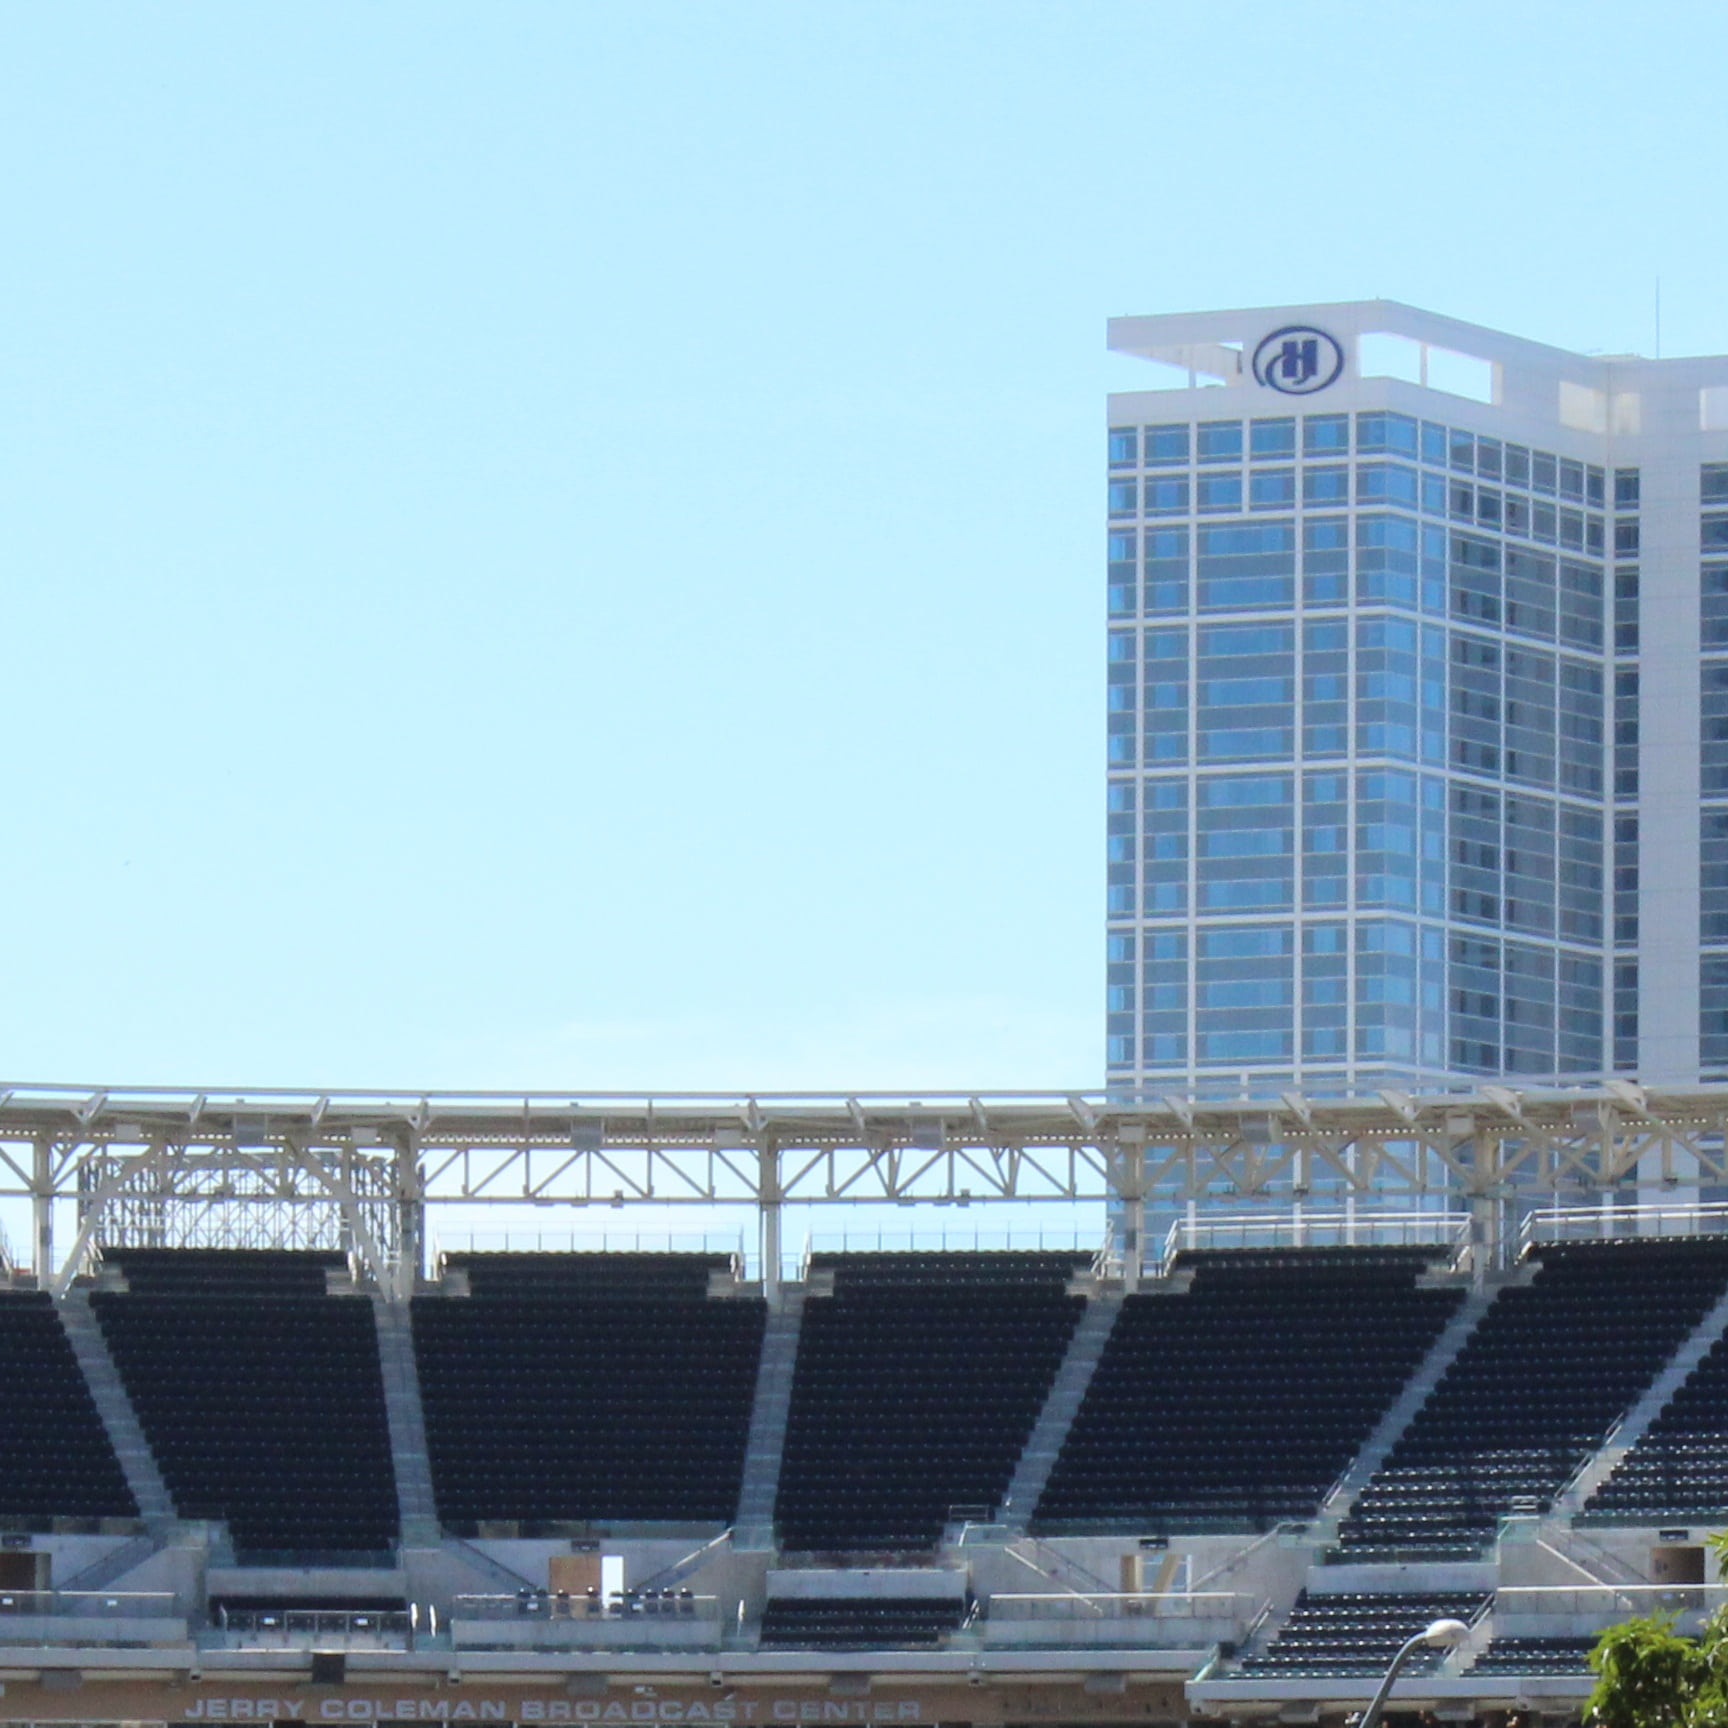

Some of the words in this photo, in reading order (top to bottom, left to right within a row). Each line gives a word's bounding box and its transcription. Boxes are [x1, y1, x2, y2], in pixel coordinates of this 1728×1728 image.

[184, 1699, 305, 1719] JERRY
[319, 1699, 506, 1719] COLEMAN
[519, 1700, 761, 1720] BROADCAST
[771, 1700, 922, 1720] CENTER
